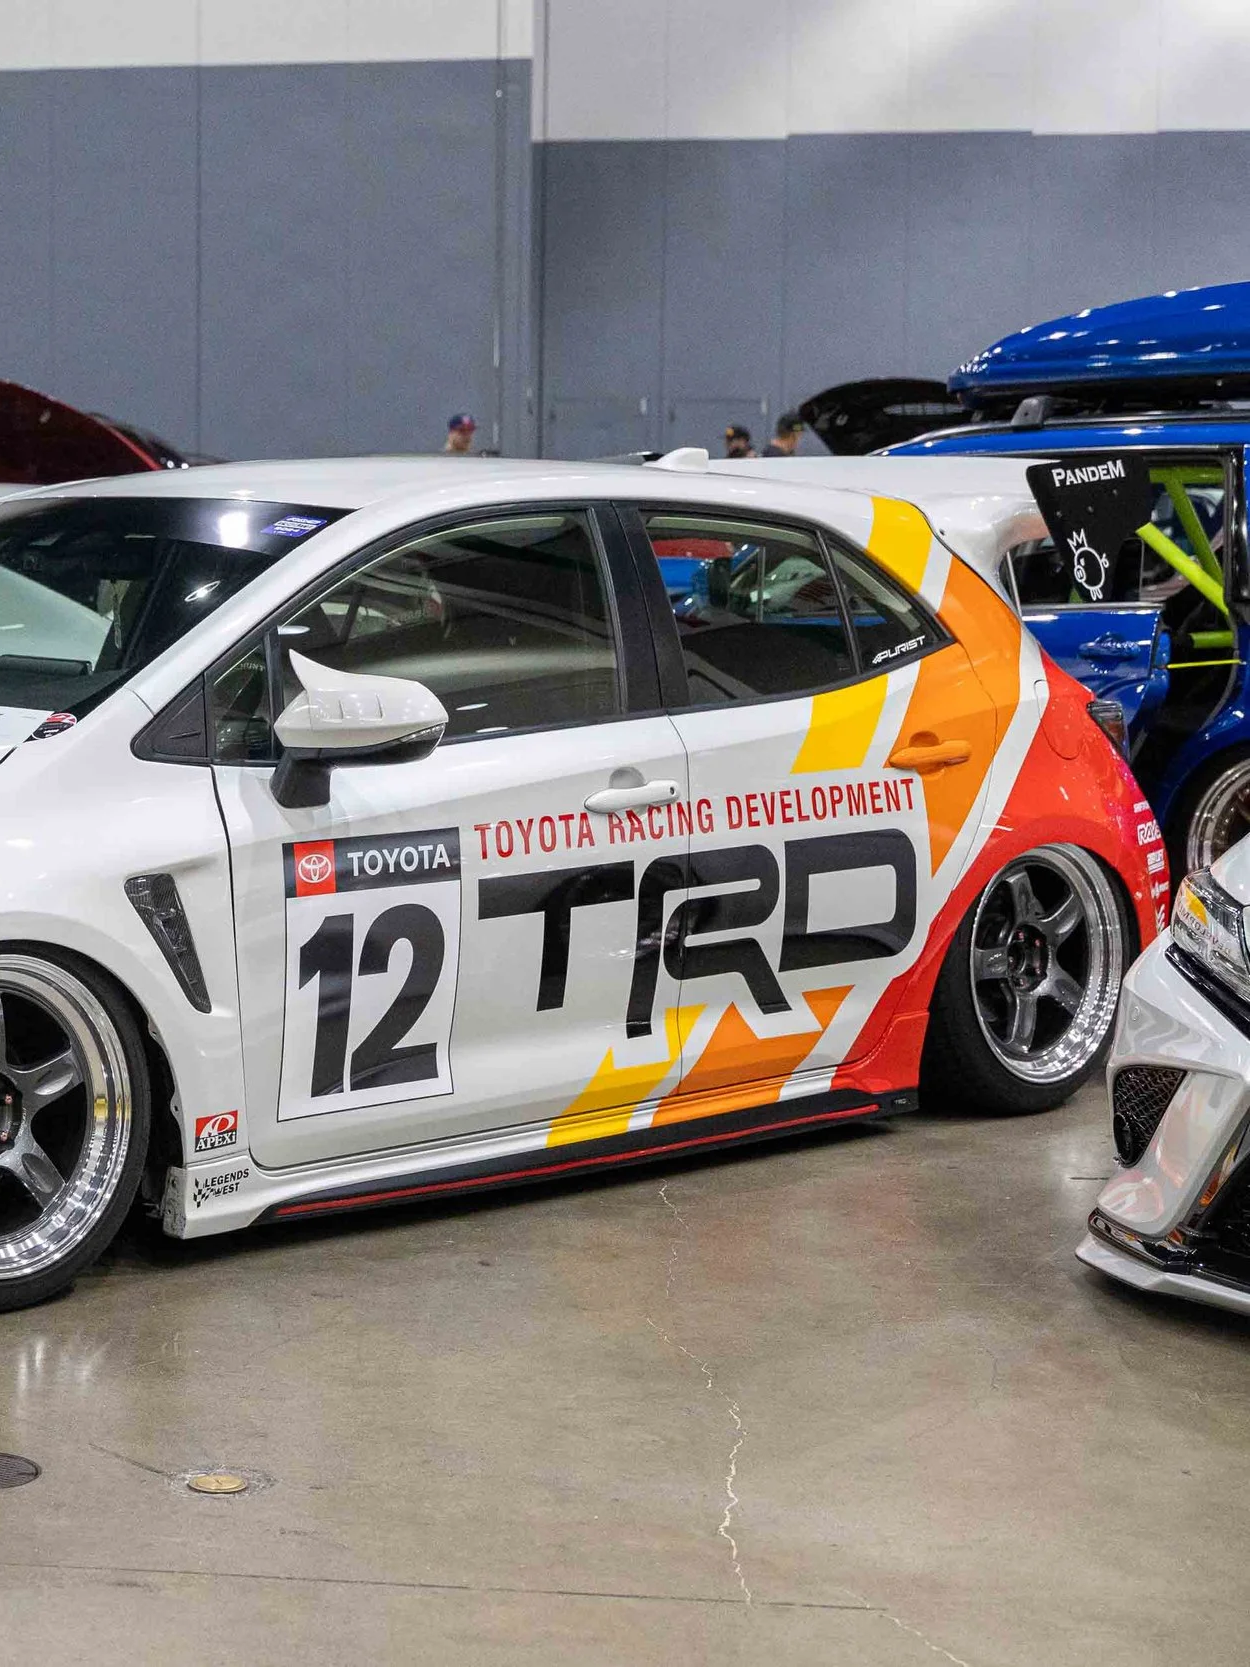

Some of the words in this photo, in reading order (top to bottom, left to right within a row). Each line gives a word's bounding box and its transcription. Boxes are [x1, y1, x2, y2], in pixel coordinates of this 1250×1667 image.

[1051, 459, 1126, 487] PANDEM
[872, 635, 925, 664] PURIST
[473, 811, 596, 861] TOYOTA
[607, 798, 715, 845] RACING
[725, 778, 915, 828] DEVELOPMENT
[347, 844, 451, 877] TOYOTA
[477, 828, 918, 1039] TRD
[299, 903, 445, 1098] 12
[204, 1168, 250, 1188] LEGENDS
[213, 1182, 240, 1197] WEST
